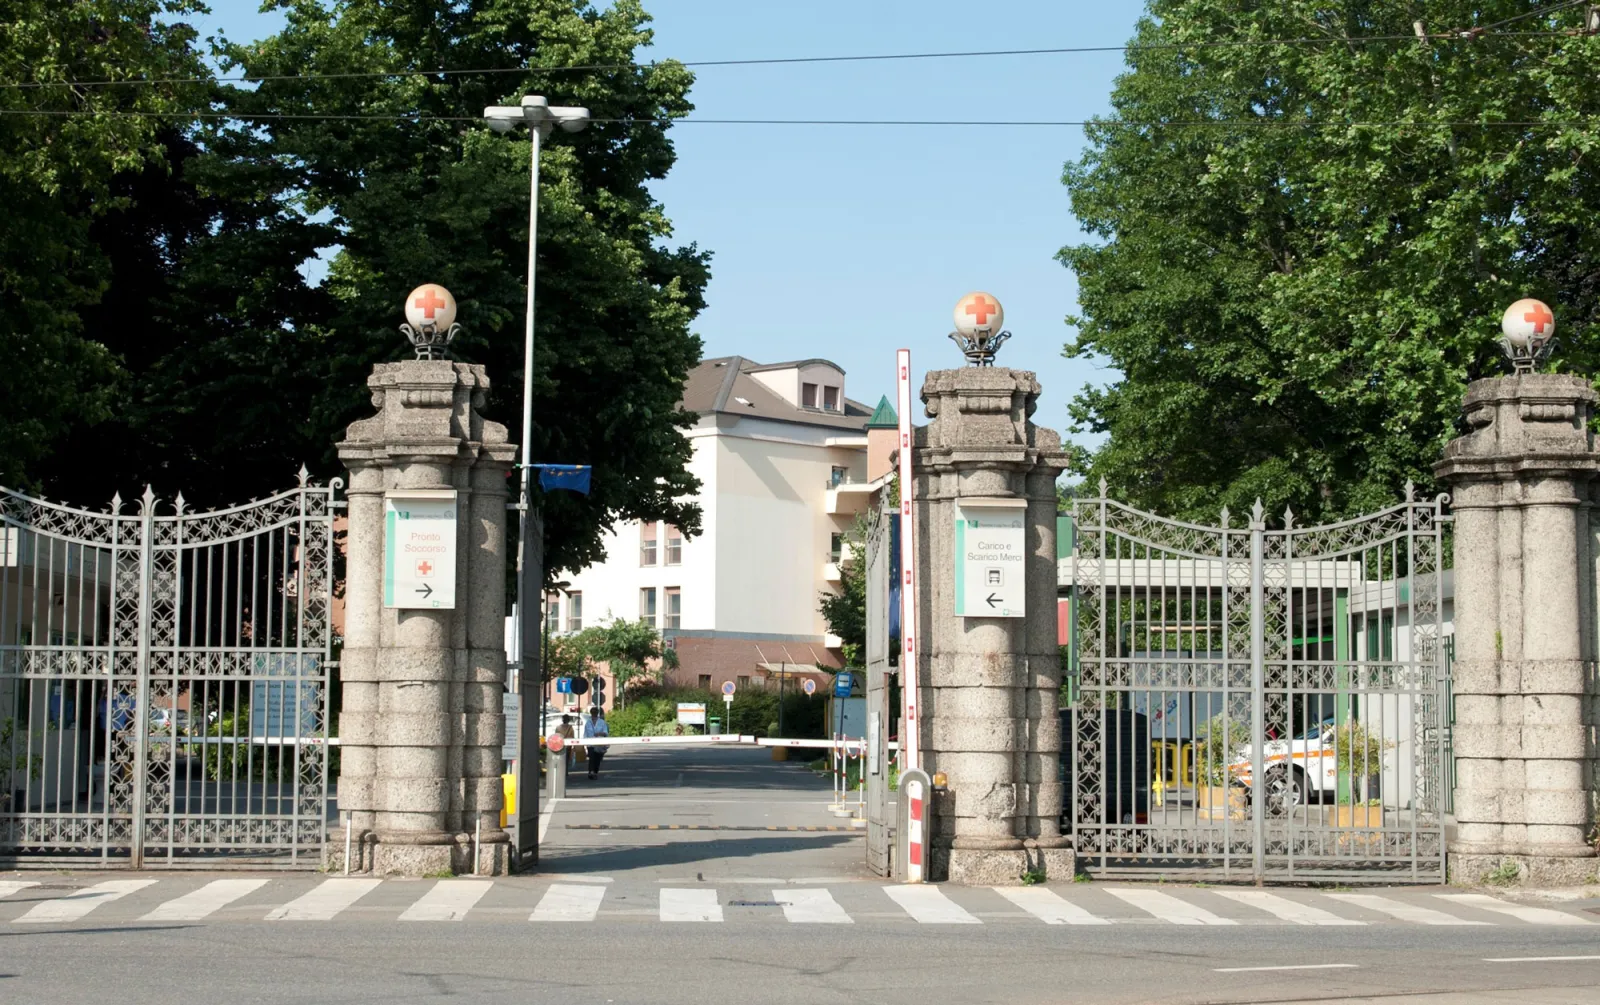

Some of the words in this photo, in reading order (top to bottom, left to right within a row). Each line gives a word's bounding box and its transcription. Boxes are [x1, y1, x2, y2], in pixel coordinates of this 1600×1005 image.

[411, 532, 440, 541] Pronto
[404, 544, 446, 553] Soccorso
[978, 541, 1004, 550] Carico
[968, 553, 998, 561] Scarico
[1000, 553, 1022, 561] Merci
